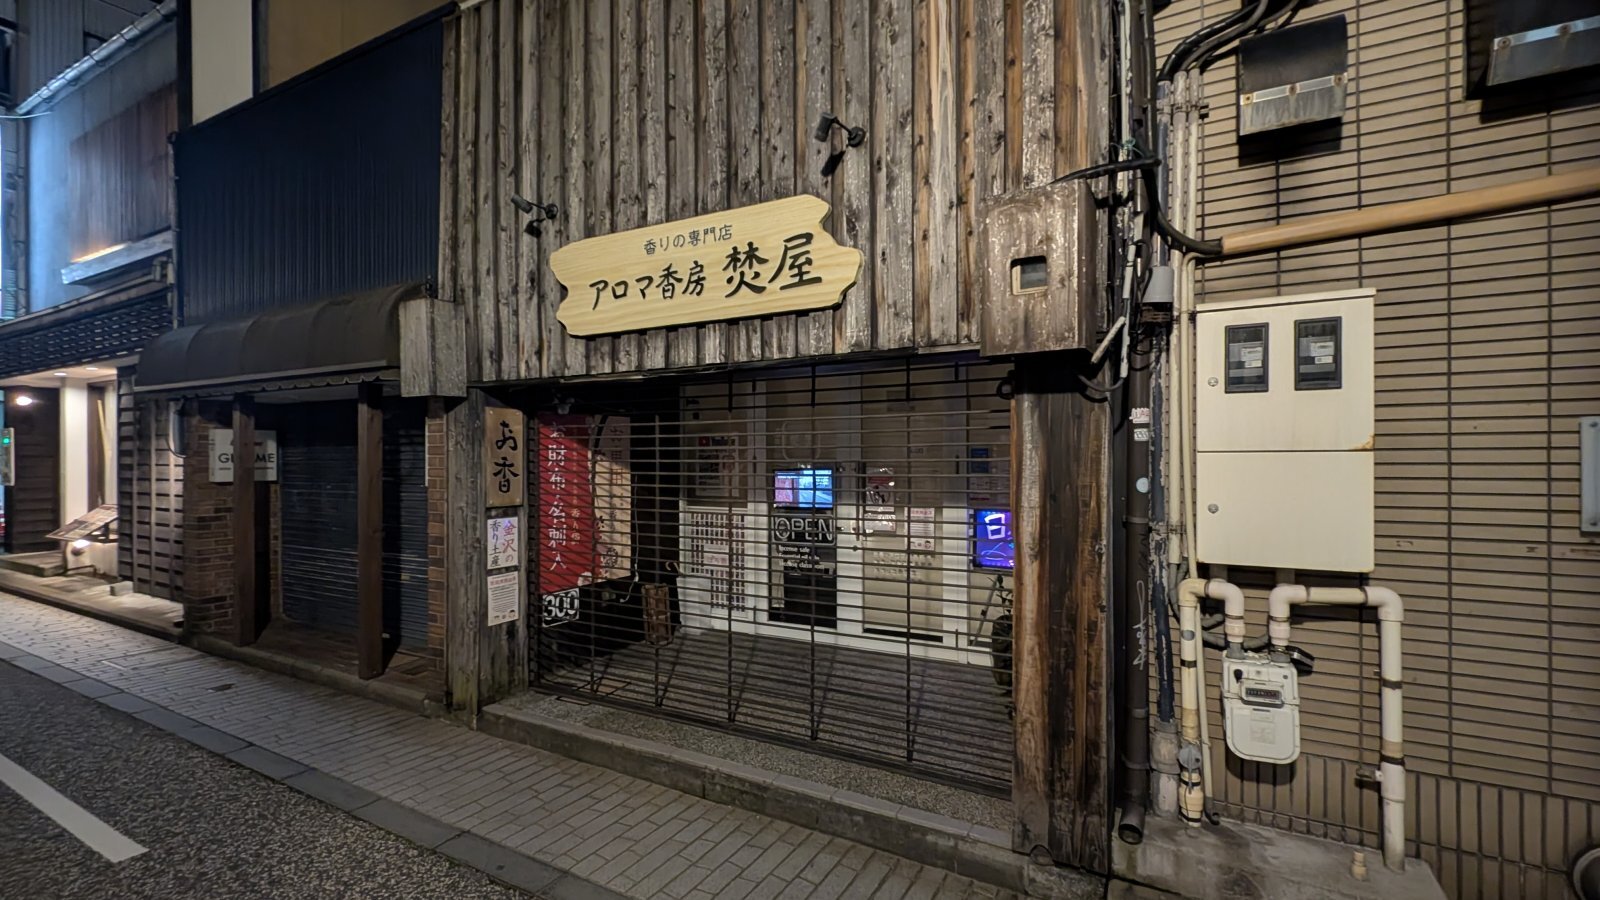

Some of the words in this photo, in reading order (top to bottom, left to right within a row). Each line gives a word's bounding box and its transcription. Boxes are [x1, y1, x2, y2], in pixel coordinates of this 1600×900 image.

[643, 224, 733, 256] 香りの専門店
[588, 260, 706, 311] アロマ香房
[722, 232, 823, 298] 焚屋
[493, 419, 520, 494] お香
[489, 519, 502, 567] 香り土産
[502, 520, 517, 563] 金沢の
[775, 517, 833, 541] OPEN
